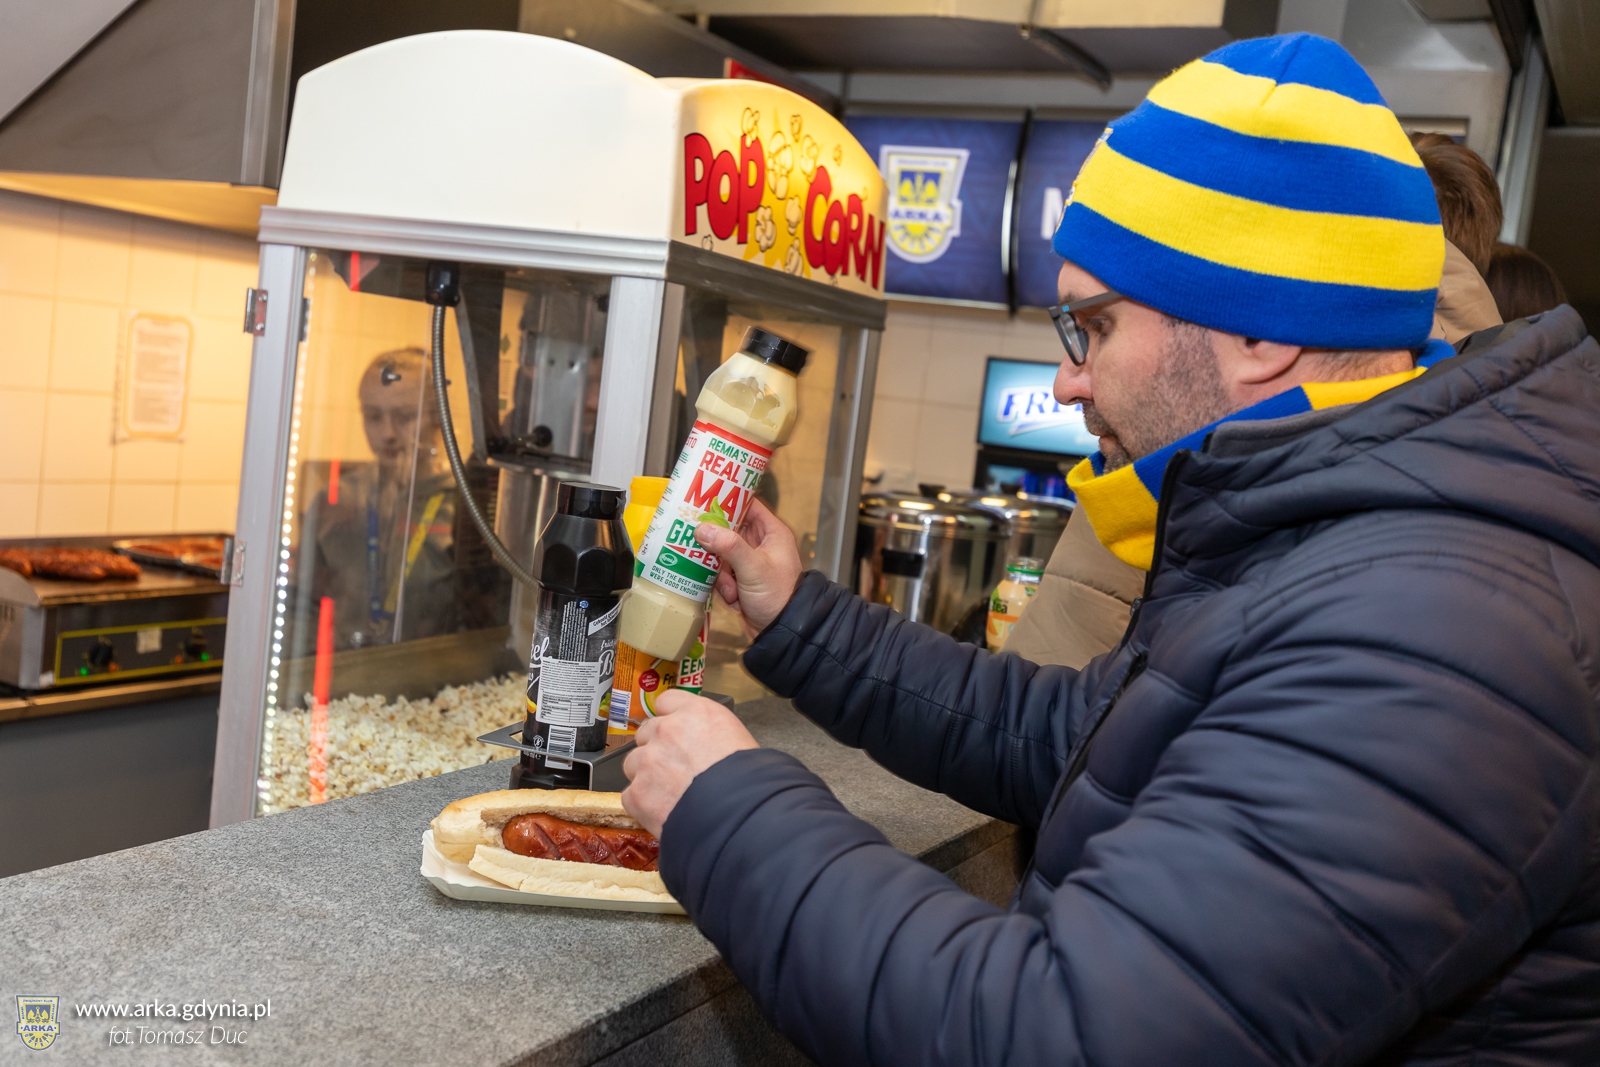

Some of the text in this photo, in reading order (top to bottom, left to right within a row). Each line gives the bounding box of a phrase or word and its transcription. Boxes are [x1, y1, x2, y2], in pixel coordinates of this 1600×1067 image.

[684, 132, 886, 291] POP CORN
[708, 437, 749, 464] REMIA'S
[699, 450, 741, 484] REAL
[649, 571, 699, 597] WERE GOOD ENOUGH
[651, 565, 666, 576] ONLY
[667, 572, 678, 581] THE
[678, 576, 691, 587] BEST
